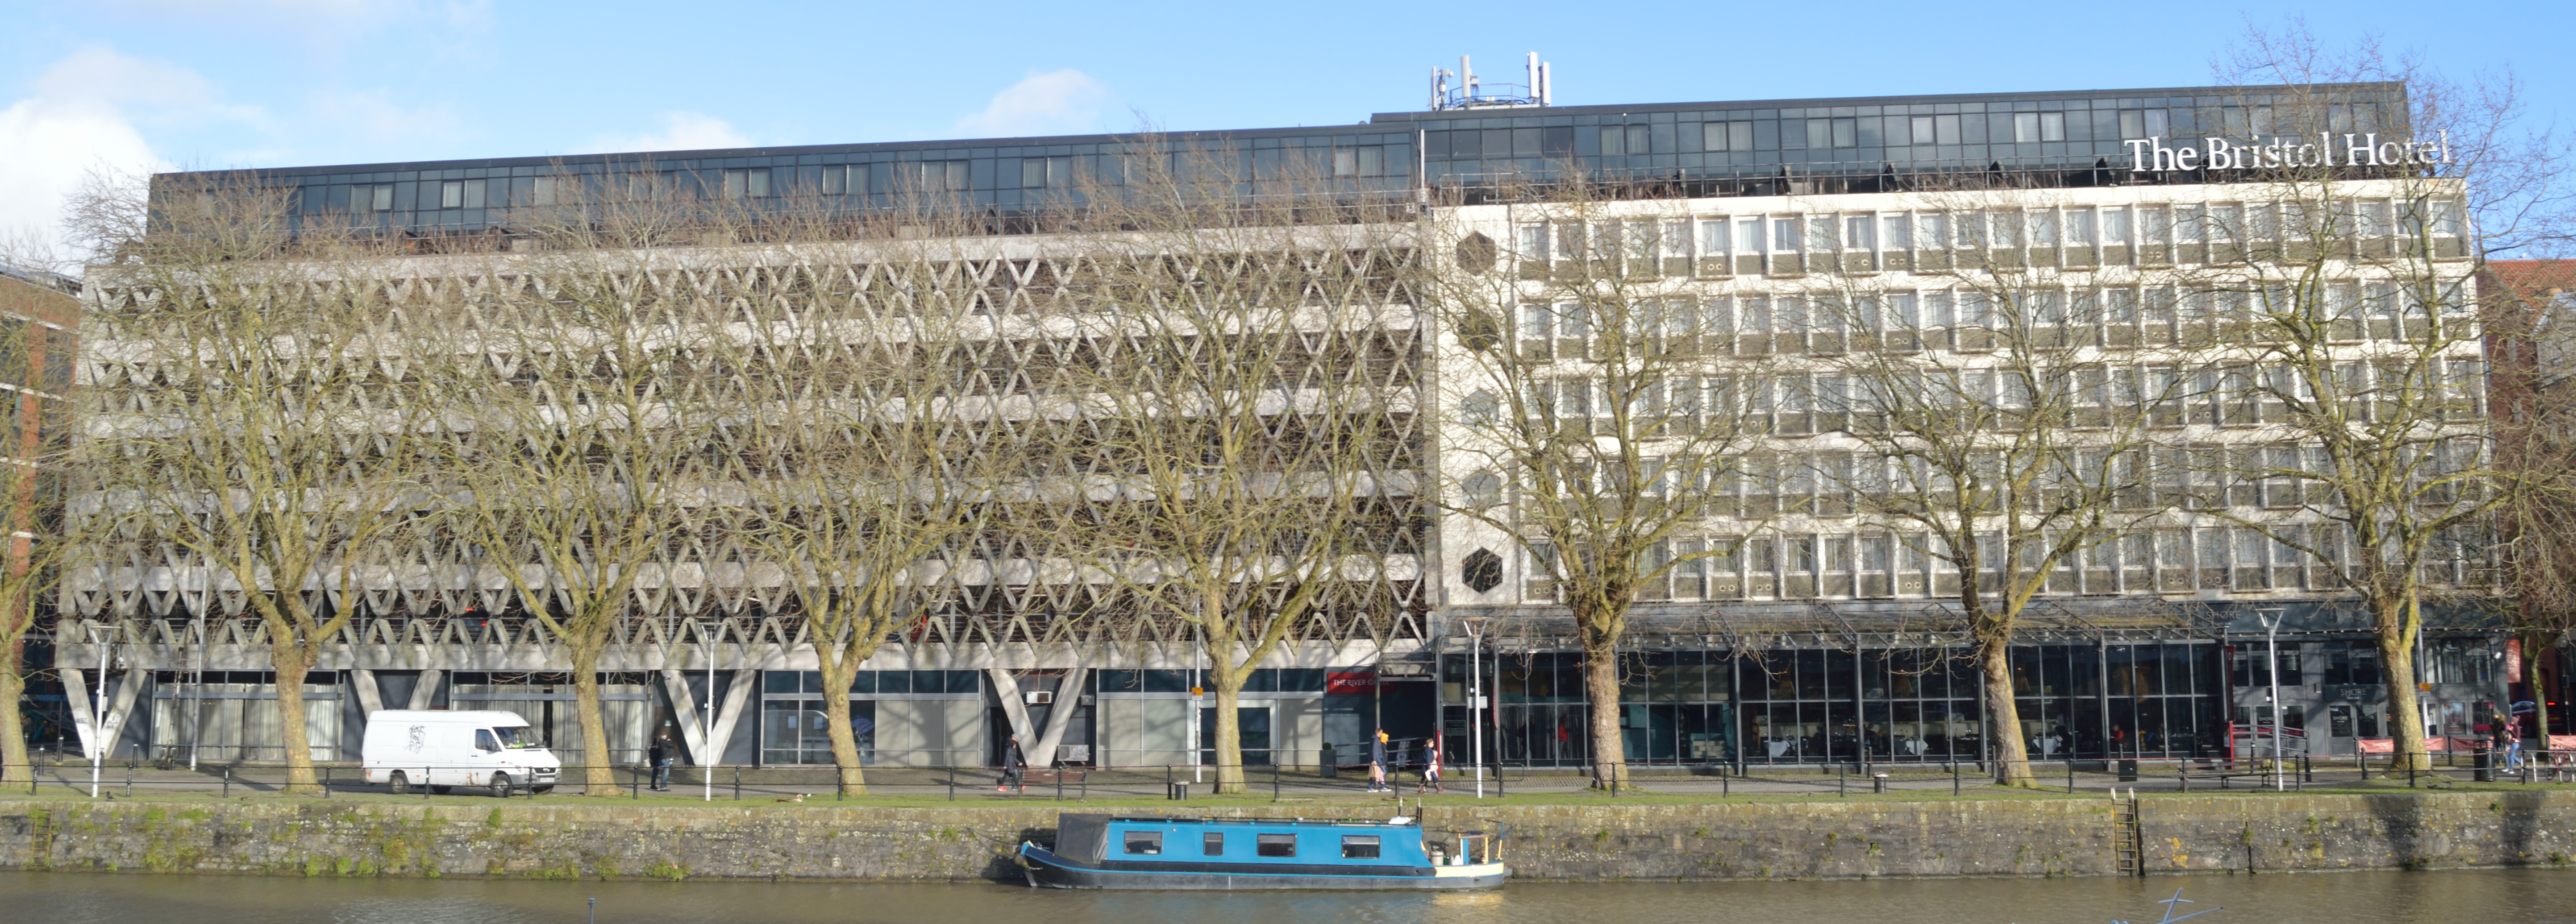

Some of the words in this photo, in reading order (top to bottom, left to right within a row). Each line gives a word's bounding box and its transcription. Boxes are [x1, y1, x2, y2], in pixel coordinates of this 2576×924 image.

[2124, 136, 2197, 172] The
[2205, 131, 2336, 170] Bristol
[2344, 129, 2452, 166] Hotel
[2206, 611, 2241, 619] SHORE
[2506, 648, 2515, 675] SHORE
